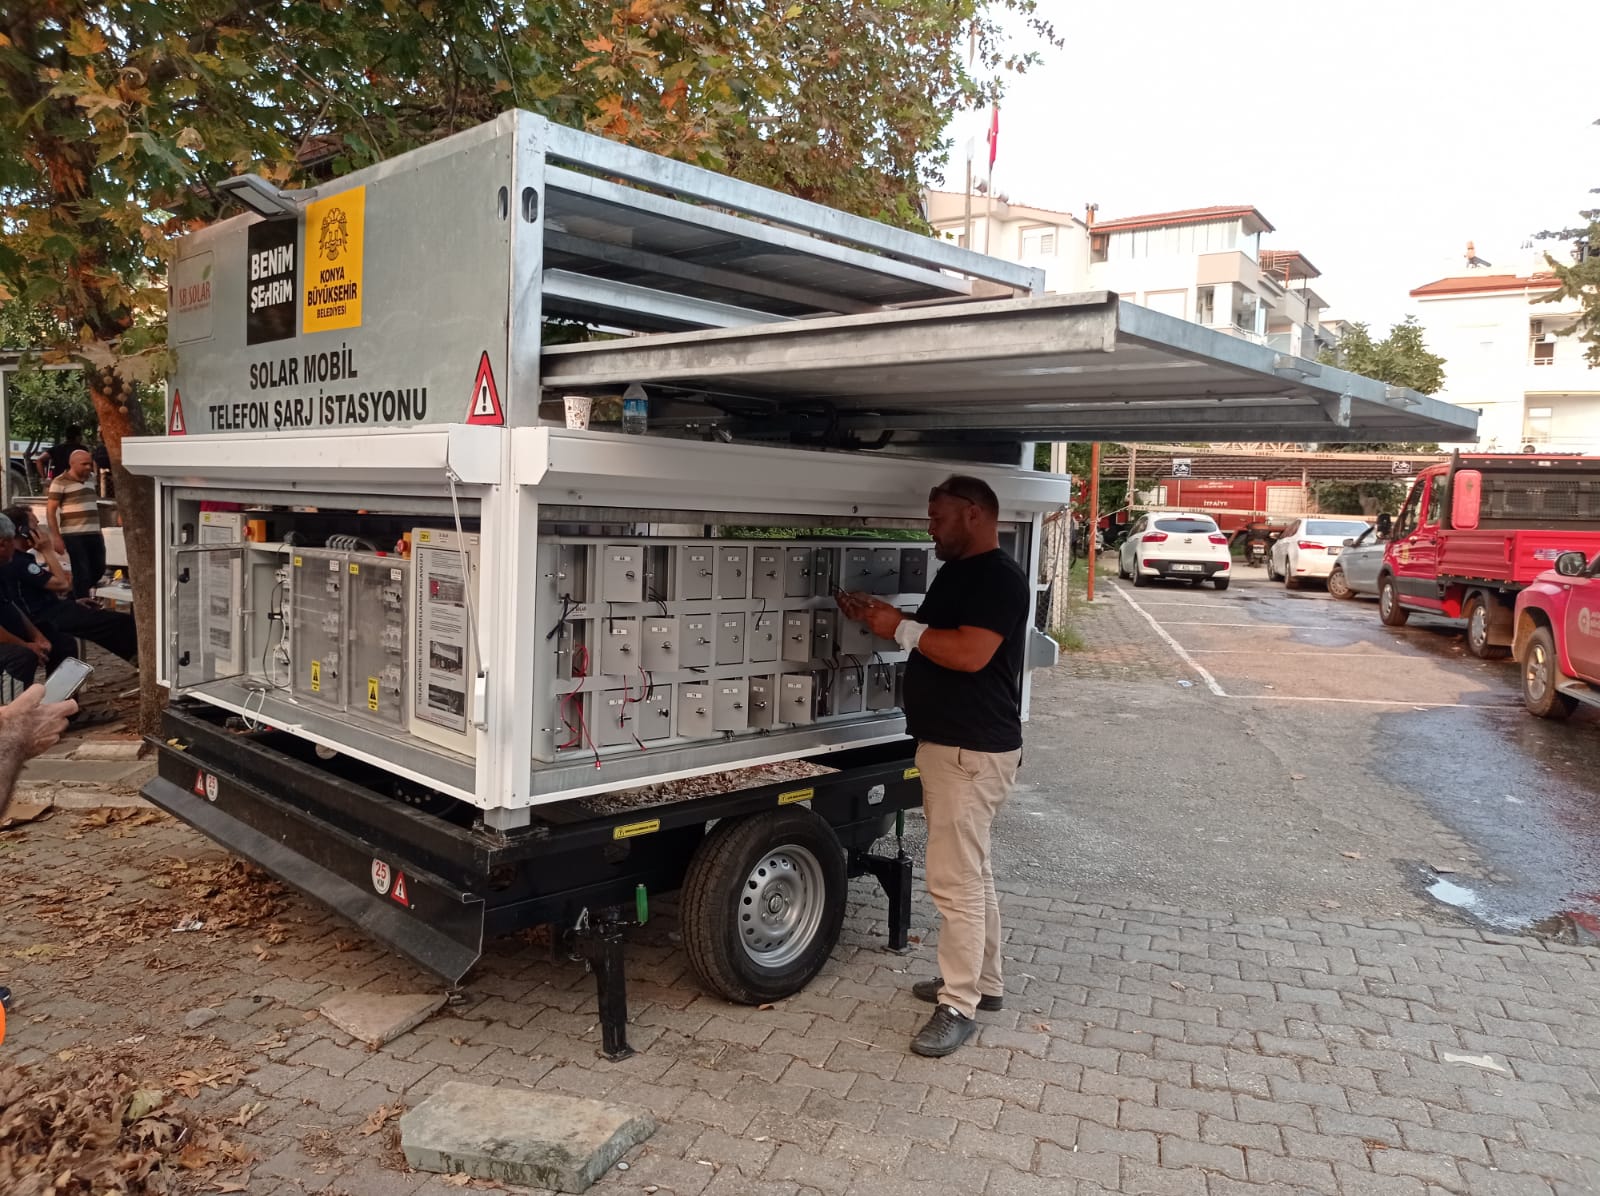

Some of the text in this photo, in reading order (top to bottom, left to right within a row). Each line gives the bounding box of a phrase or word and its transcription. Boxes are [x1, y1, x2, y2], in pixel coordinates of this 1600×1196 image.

[319, 266, 345, 284] KONYA
[189, 281, 211, 304] SOLAR
[307, 280, 358, 306] BÜYÜKŞEHİR
[316, 305, 347, 319] BELEDİYESİ
[250, 342, 358, 390] SOLAR MOBİL
[209, 388, 427, 431] TELEFON ŞARJ İSTASYONU
[375, 861, 387, 880] 25
